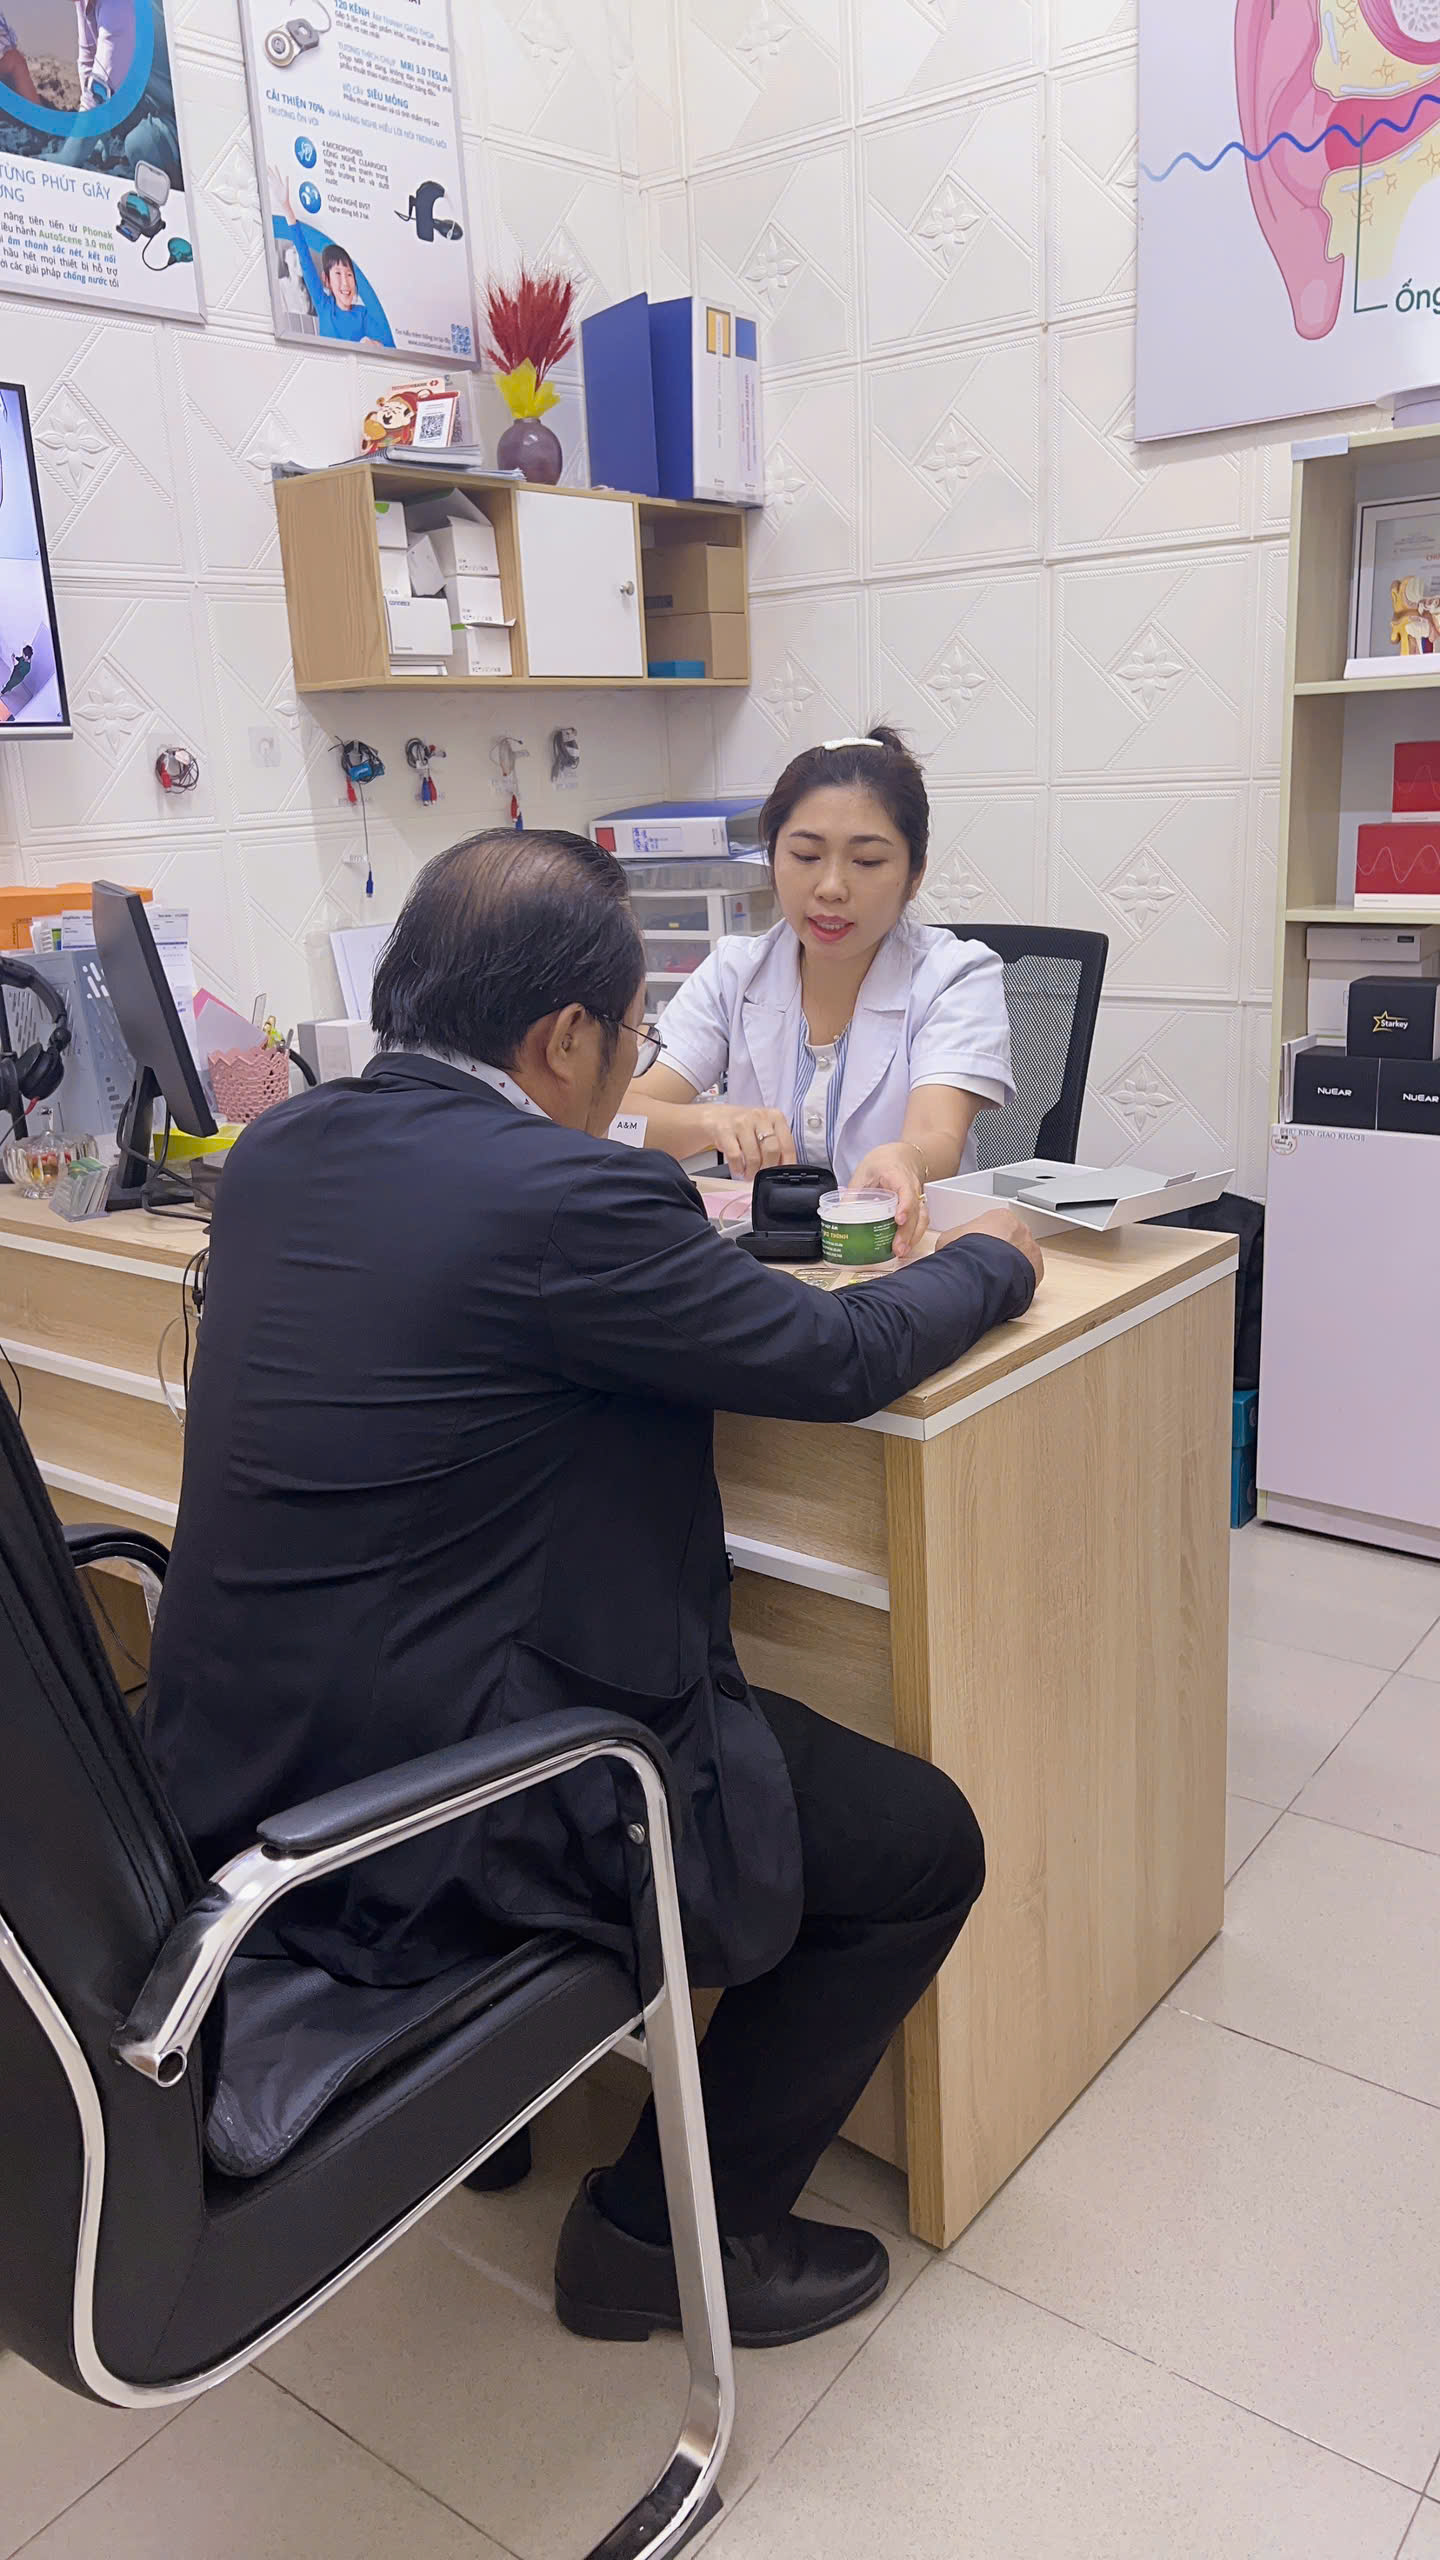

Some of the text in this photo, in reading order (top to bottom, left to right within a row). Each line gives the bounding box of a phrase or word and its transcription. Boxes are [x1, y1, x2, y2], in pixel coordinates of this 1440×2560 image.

[427, 69, 448, 83] TESLA
[308, 101, 326, 115] 70%
[42, 173, 76, 192] PHÚT
[82, 182, 111, 200] GIÂY
[15, 223, 37, 236] hành
[39, 230, 82, 245] AutoScene
[85, 239, 97, 248] 3.0
[82, 226, 113, 239] Phonak
[25, 239, 49, 252] thanh
[23, 250, 37, 261] hết
[41, 255, 56, 266] mọi
[41, 267, 61, 279] pháp
[63, 271, 87, 285] chống
[1380, 1019, 1408, 1029] Starkey
[617, 1121, 638, 1130] A&M
[1316, 1131, 1336, 1140] GIAO
